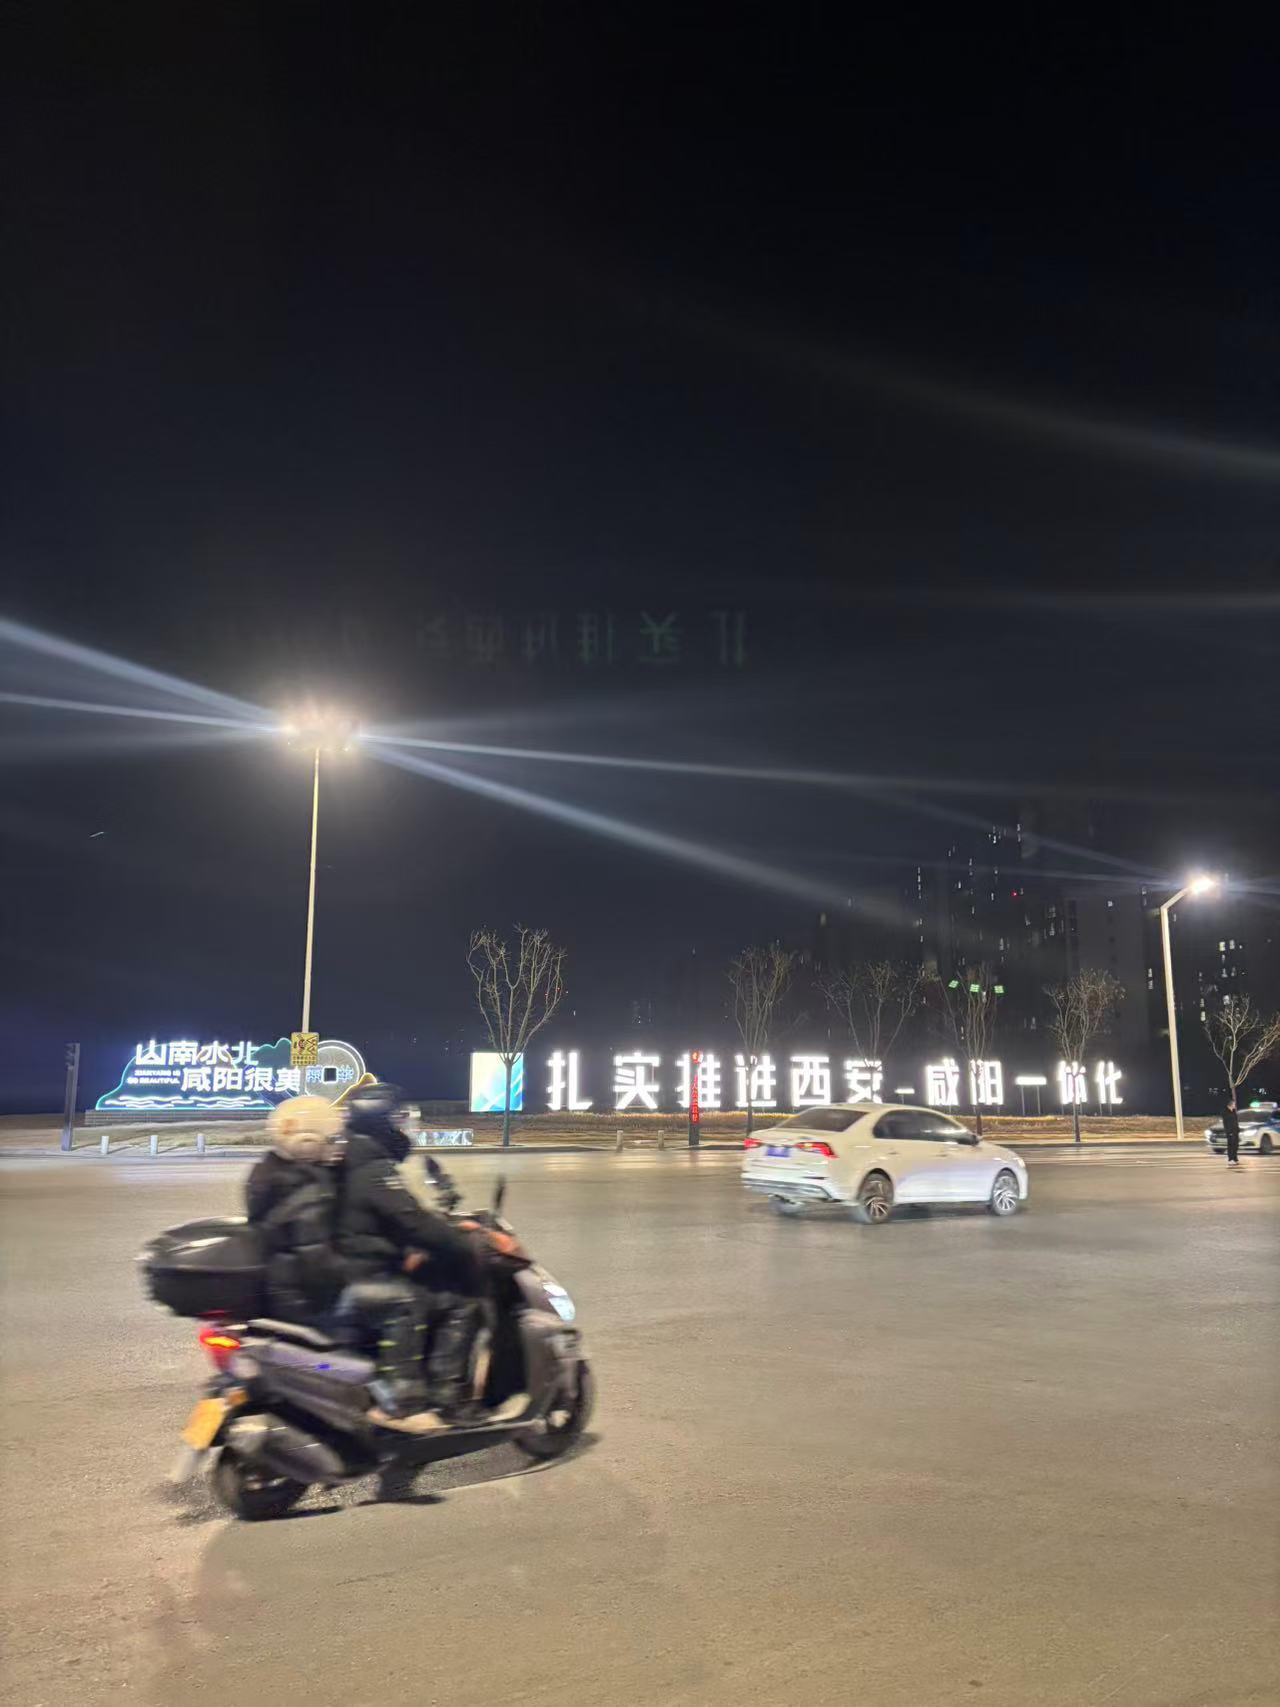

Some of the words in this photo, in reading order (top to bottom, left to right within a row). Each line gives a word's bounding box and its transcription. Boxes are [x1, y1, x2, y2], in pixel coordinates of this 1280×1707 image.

[135, 1039, 258, 1066] 山南水北
[181, 1067, 301, 1093] 咸阳很美
